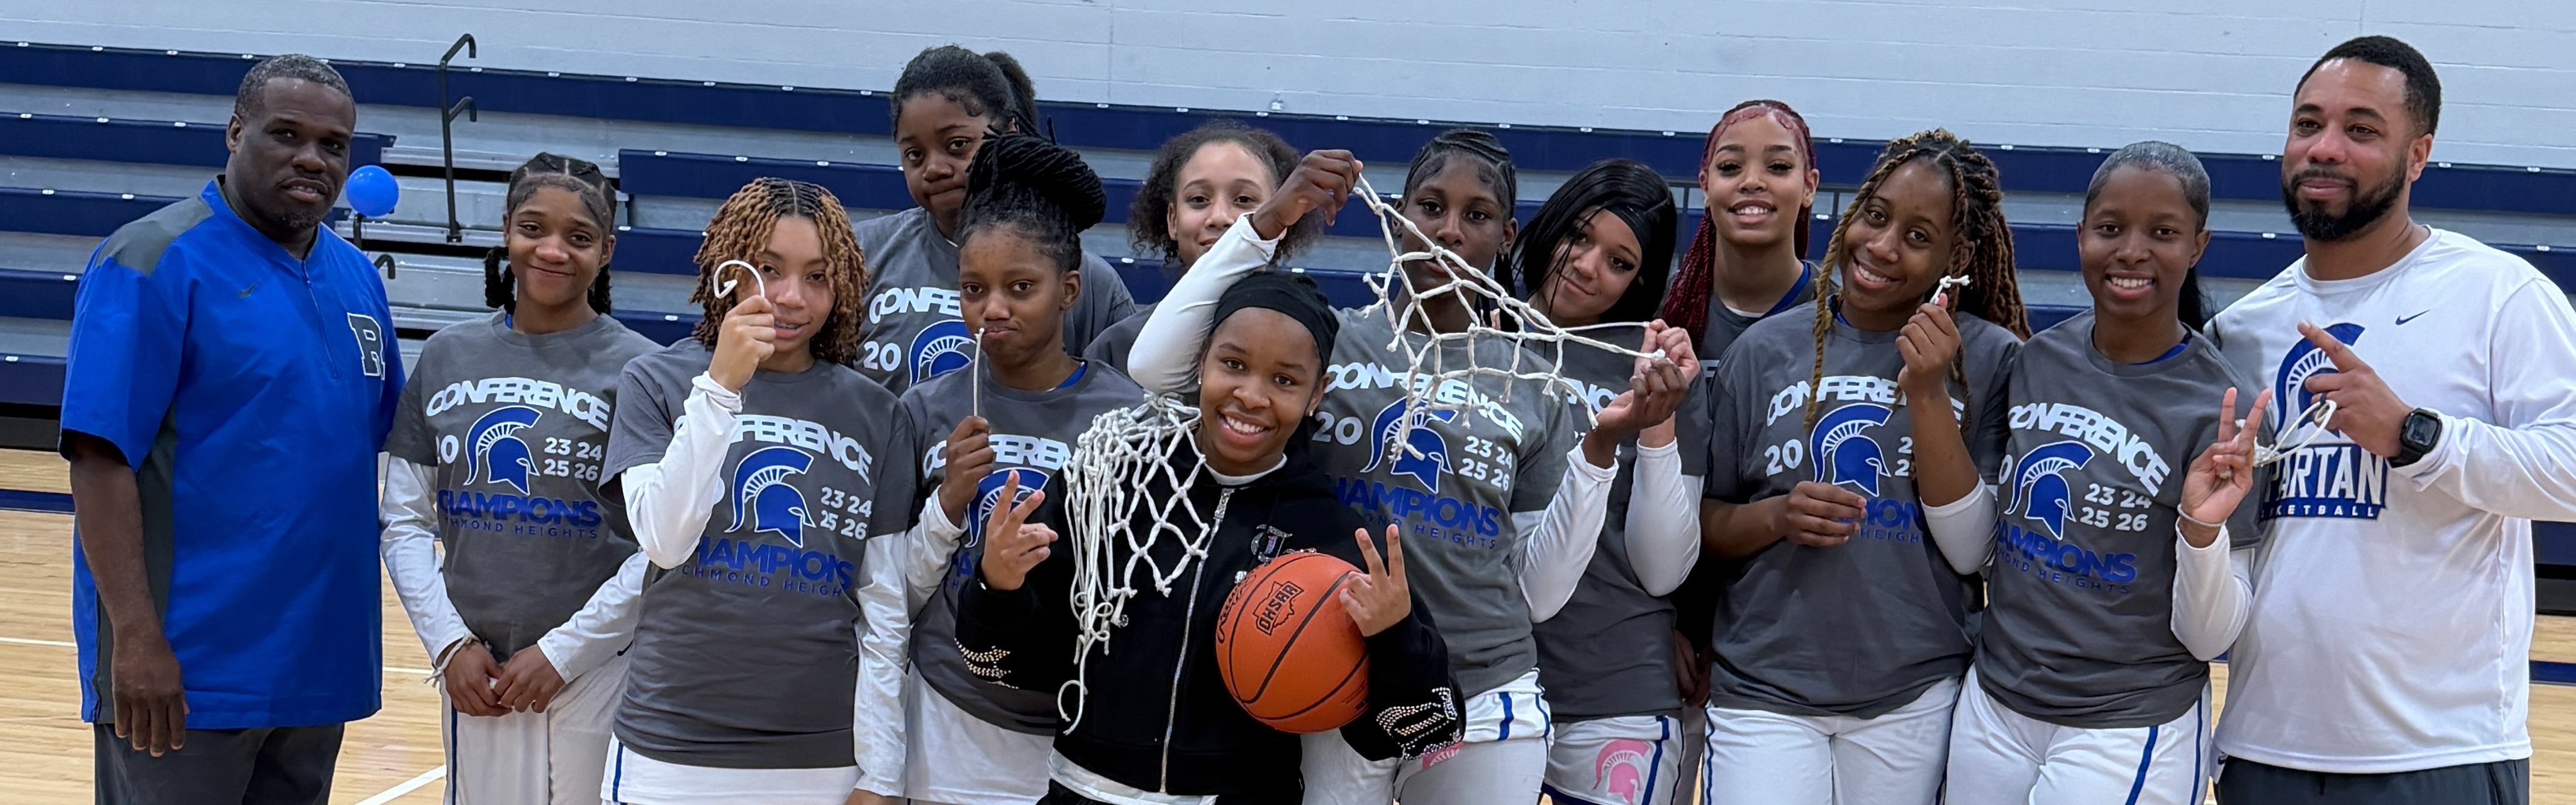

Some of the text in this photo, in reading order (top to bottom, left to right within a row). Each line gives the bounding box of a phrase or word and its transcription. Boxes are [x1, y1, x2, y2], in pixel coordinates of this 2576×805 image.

[869, 287, 963, 324] CONFE
[347, 312, 385, 380] R
[863, 341, 901, 371] 20
[426, 377, 610, 432] CONFERENCE
[1312, 412, 1363, 445] 20
[435, 434, 459, 464] 0
[544, 437, 602, 461] 23 24
[673, 415, 872, 486] FERENCE
[1464, 436, 1512, 469] 23 24
[1764, 439, 1803, 477] 20
[1898, 437, 1913, 454] 2
[2008, 402, 2170, 497] CONFERENCE
[544, 459, 598, 481] 25 26
[1459, 458, 1510, 492] 25 26
[1895, 459, 1912, 477] 2
[1998, 454, 2013, 484] 0
[2264, 446, 2382, 505] PARTAN
[821, 487, 872, 518] 23 24
[2084, 483, 2151, 509] 23 24
[515, 524, 597, 539] HEIGHTS
[820, 510, 868, 540] 25 26
[2080, 507, 2148, 531] 25 26
[1415, 525, 1495, 549] HEIGHTS
[1860, 529, 1919, 543] HEIGH
[682, 564, 842, 598] CHMOND HEIGH
[2039, 568, 2130, 595] HEIGHTS
[1263, 584, 1299, 632] OHSAA
